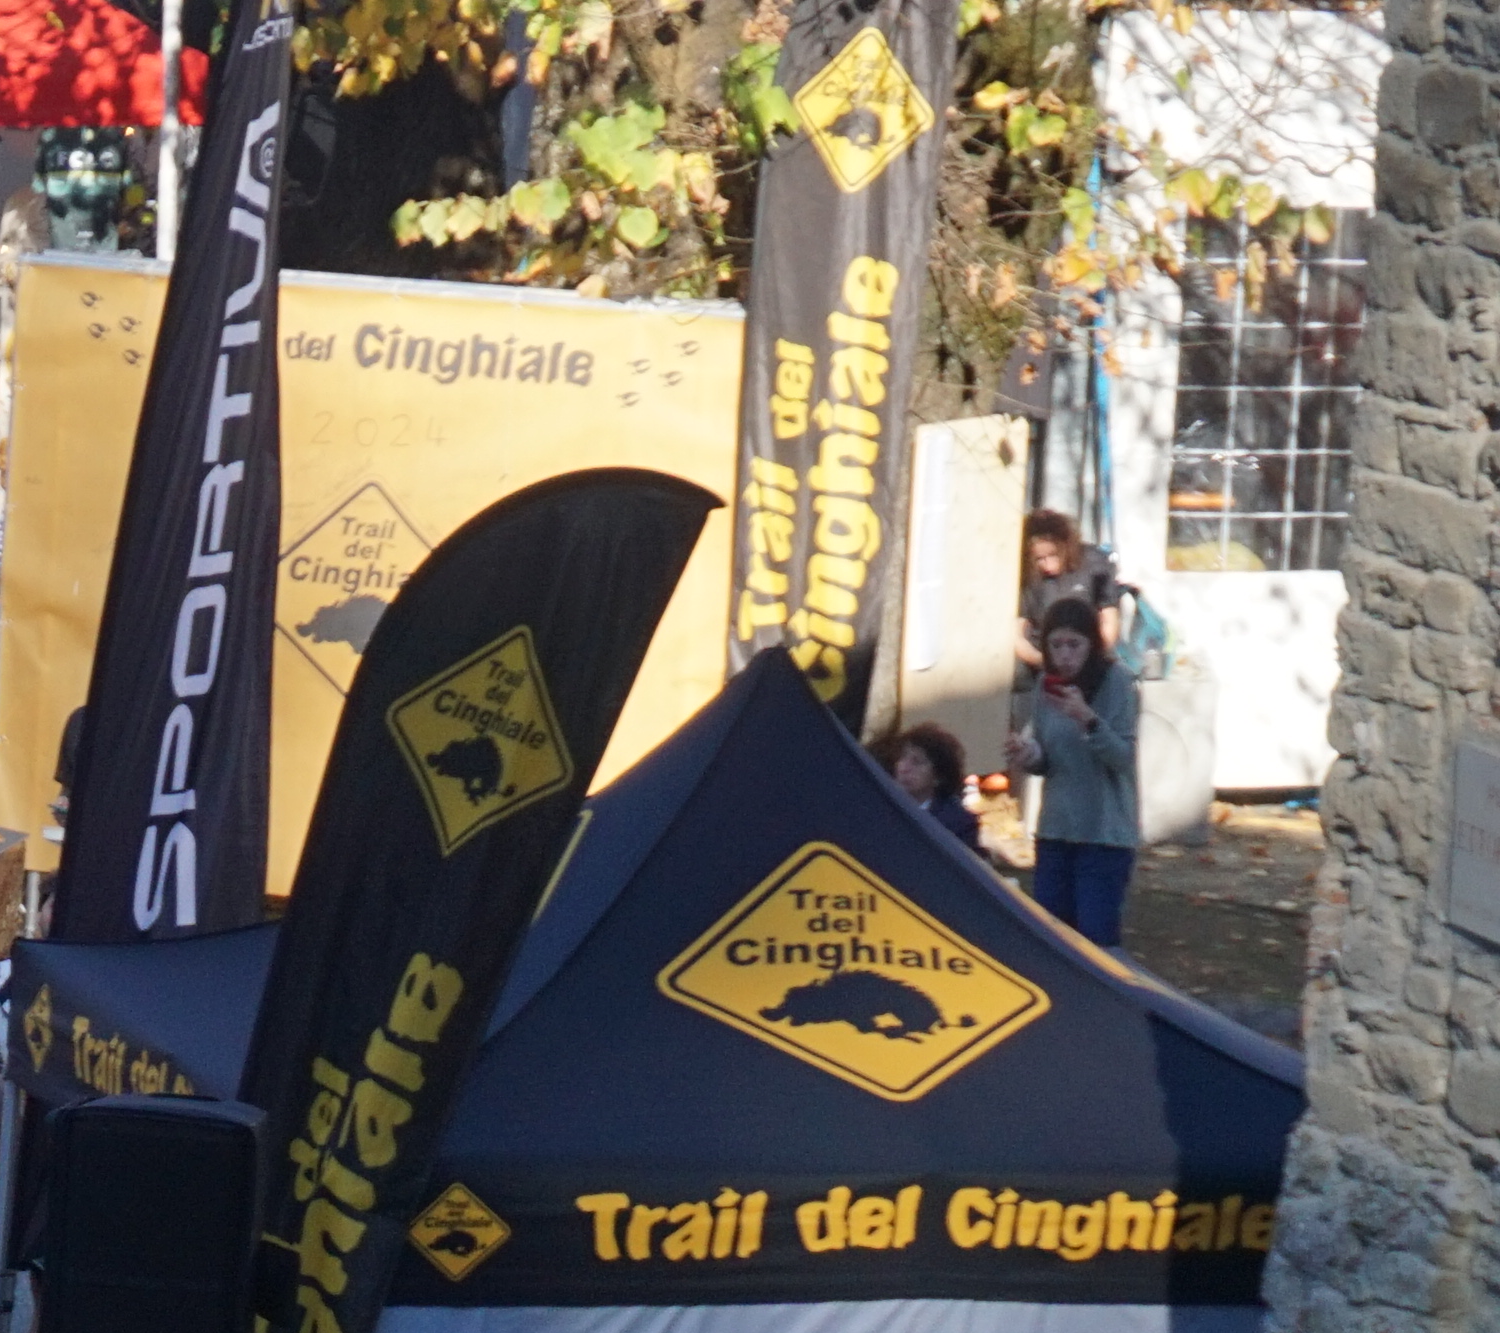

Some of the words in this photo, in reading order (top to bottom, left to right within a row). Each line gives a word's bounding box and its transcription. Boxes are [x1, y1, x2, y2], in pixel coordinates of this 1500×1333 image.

[287, 332, 337, 363] del
[354, 323, 596, 387] Cinghiale
[773, 338, 813, 442] del
[311, 412, 448, 450] 2024
[788, 255, 902, 701] Cinghiale
[339, 517, 397, 542] Trail
[343, 538, 382, 560] del
[739, 458, 798, 641] Trail
[484, 657, 529, 690] Trail
[432, 688, 549, 752] Cinghiale
[788, 887, 879, 914] Trail
[806, 911, 867, 935] del
[725, 937, 974, 977] Cinghiale
[290, 1056, 351, 1201] del
[578, 1189, 767, 1260] Trail
[797, 1186, 922, 1252] del
[946, 1187, 1280, 1262] Cinghiale
